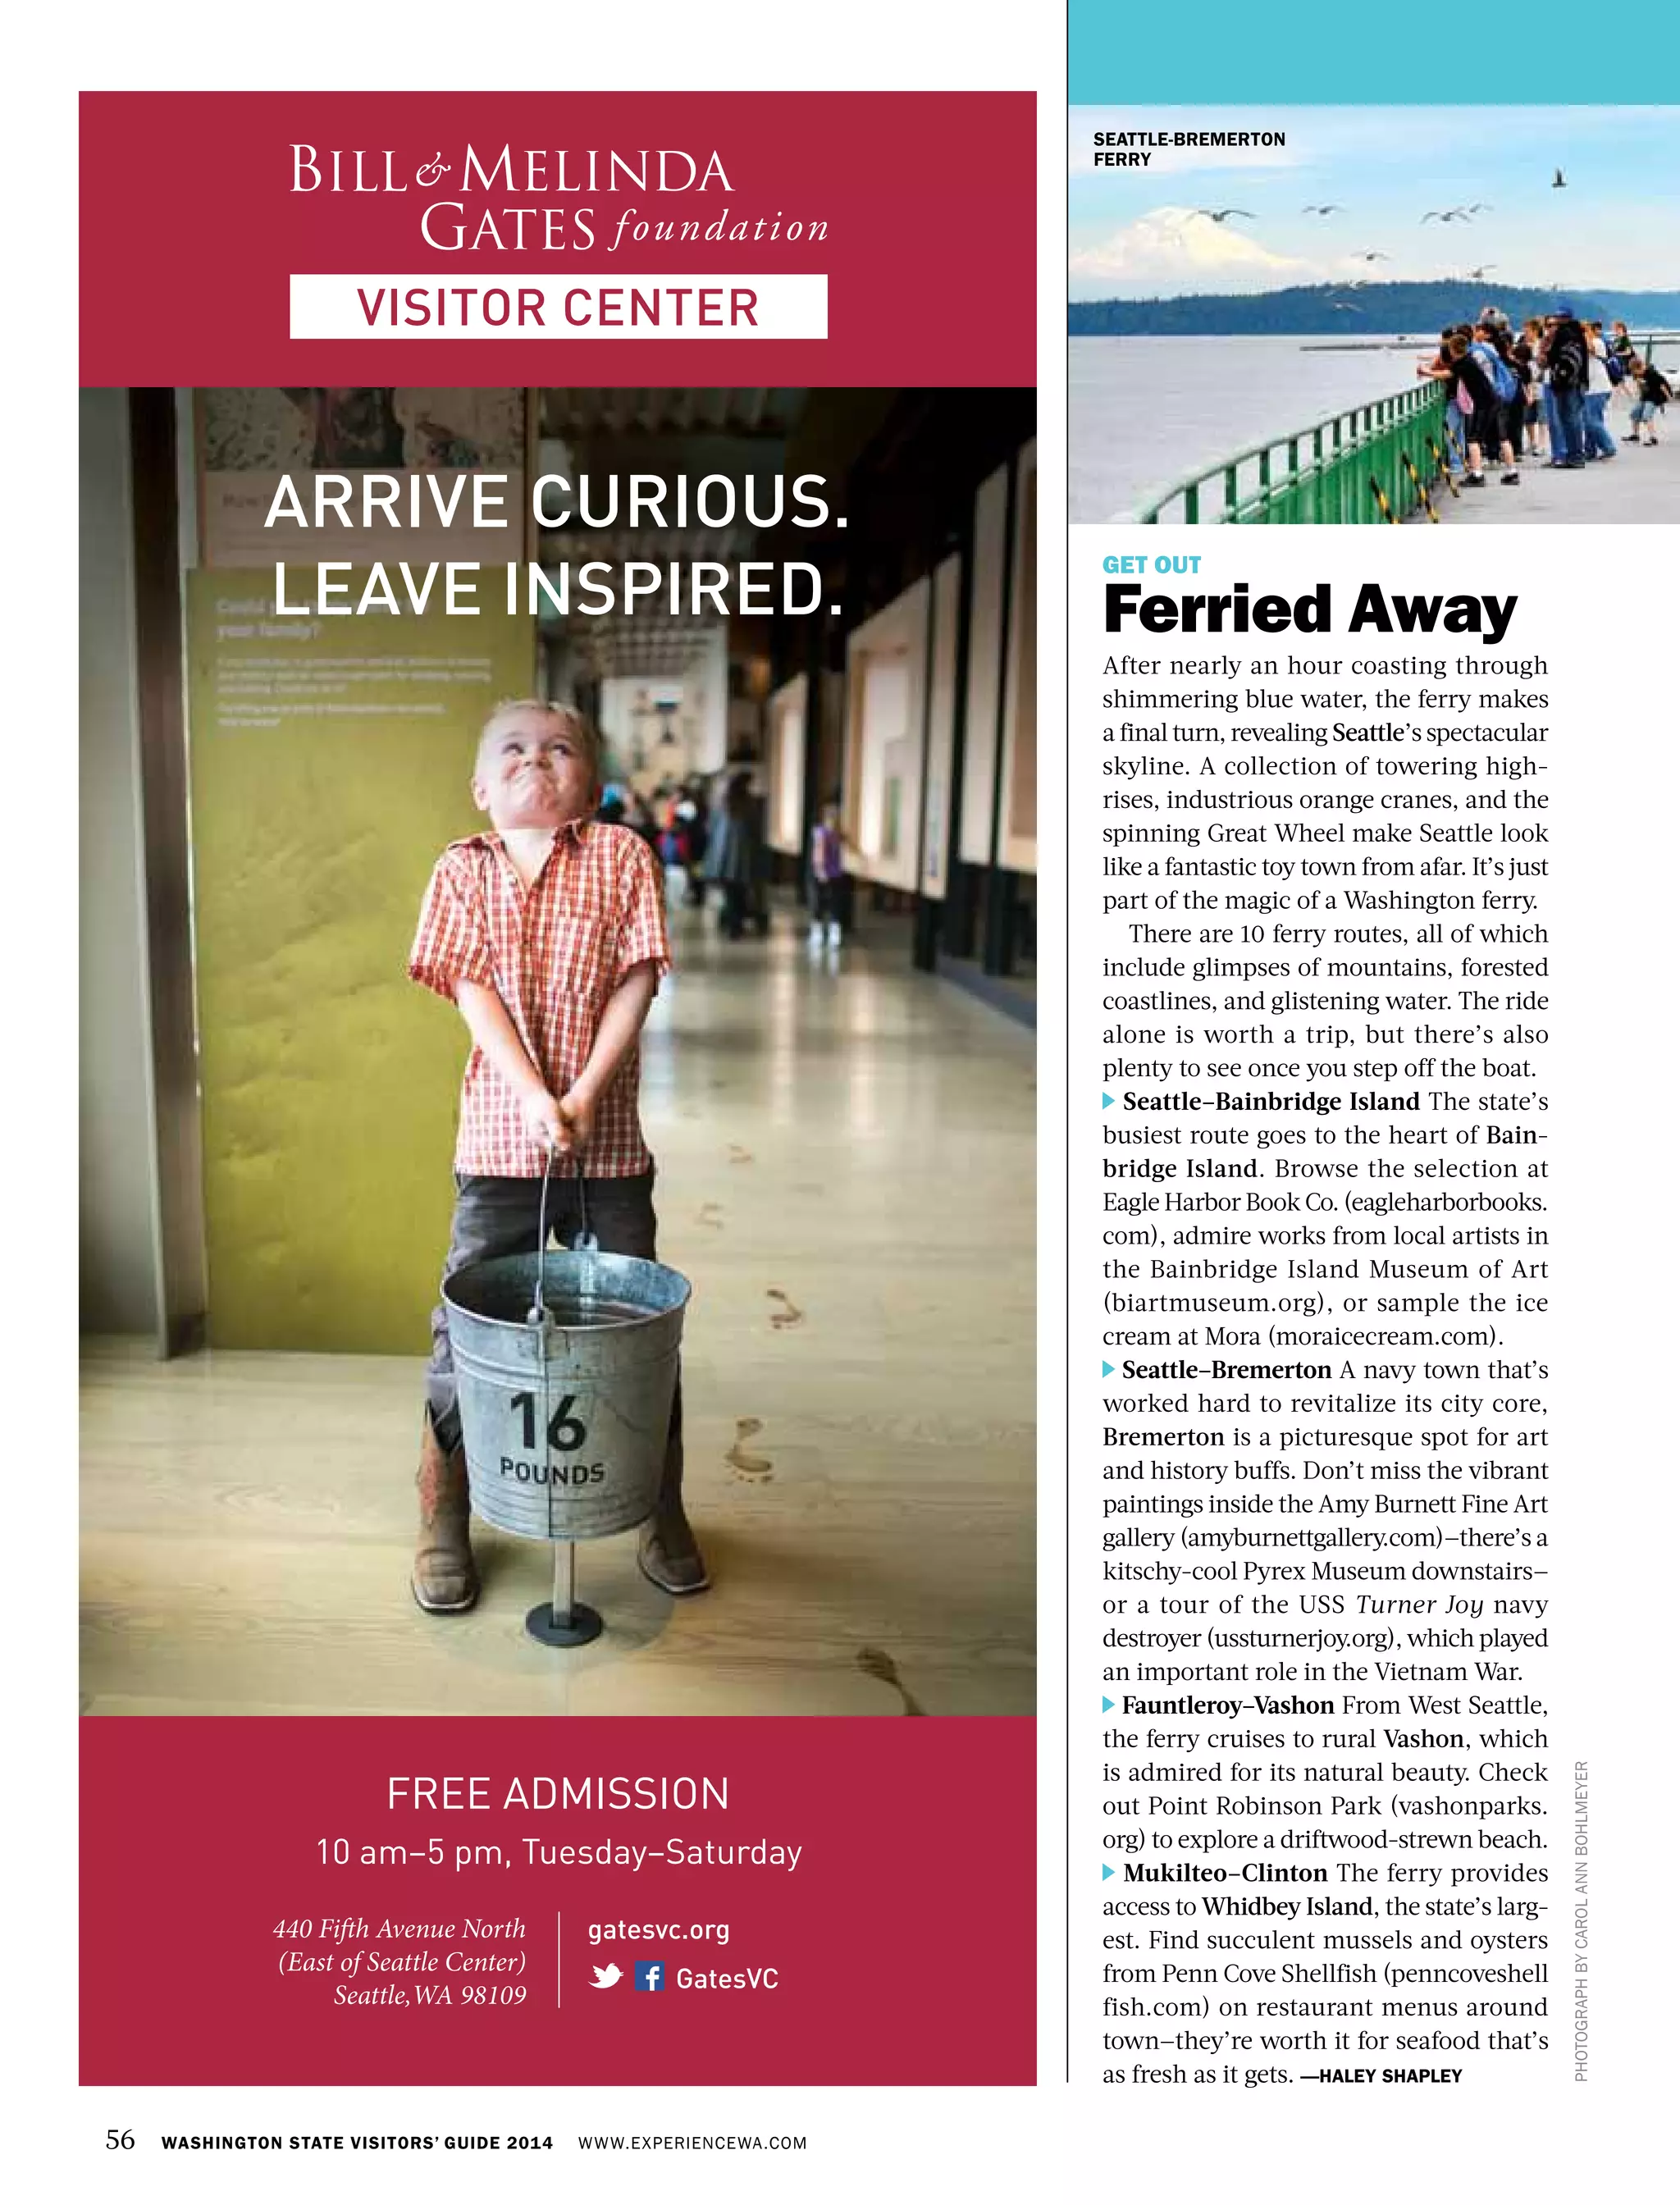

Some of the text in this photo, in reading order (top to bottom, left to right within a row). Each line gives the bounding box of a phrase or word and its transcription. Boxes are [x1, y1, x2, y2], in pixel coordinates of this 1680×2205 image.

[1093, 131, 1285, 147] SEATTLE-BREMERTON
[415, 150, 453, 189] &
[1094, 152, 1152, 167] FERRY
[607, 208, 828, 252] foundation
[357, 288, 758, 326] VISITOR CENTER
[263, 474, 847, 527] ARRIVE CURIOUS.
[1102, 555, 1202, 574] GET OUT
[276, 561, 841, 615] LEAVE INSPIRED.
[1105, 582, 1519, 645] Ferried Away
[1102, 655, 1549, 680] After nearly an hour coasting through
[1102, 722, 1550, 747] a final turn, revealing Seattle’s spectacular
[1102, 823, 1550, 847] spinning Great Wheel make Seattle look
[1102, 990, 1549, 1016] coastlines, and glistening water. The ride
[1102, 1057, 1536, 1082] plenty to see once you step off the boat.
[1102, 1189, 1547, 1217] Eagle Harbor Book Co. (eagleharborbooks.
[1104, 1290, 1548, 1317] (biartmuseum.org), or sample the ice
[1102, 1324, 1504, 1349] cream at Mora (moraicecream.com).
[509, 1391, 588, 1452] 16
[1102, 1427, 1549, 1451] Bremerton is a picturesque spot for art
[500, 1455, 605, 1486] POUNDS
[1102, 1493, 1549, 1518] paintings inside the Amy Burnett Fine Art
[1102, 1594, 1550, 1619] or a tour of the USS Turner Joy navy
[1102, 1661, 1522, 1686] an important role in the Vietnam War.
[1102, 1728, 1549, 1753] the ferry cruises to rural Vashon, which
[389, 1776, 728, 1810] FREE ADMISSION
[317, 1838, 349, 1865] 10
[456, 1846, 511, 1872] pm,
[272, 1917, 526, 1945] 440 Fifth Avenue North
[588, 1920, 729, 1946] gatesvc.org
[1574, 1761, 1588, 2082] PHOTOGRAPH BY CAROL ANN BOHLMEYER
[279, 1950, 526, 1979] (East of Seattle Center)
[1102, 1961, 1549, 1988] from Penn Cove Shellfish (penncoveshell
[677, 1967, 778, 1989] GatesVC
[334, 1984, 527, 2007] Seattle, WA 98109
[1102, 2069, 1125, 2084] as
[1132, 2063, 1188, 2084] fresh
[1194, 2069, 1217, 2084] as
[1222, 2065, 1239, 2084] it
[1244, 2066, 1294, 2089] gets.
[1381, 2068, 1463, 2084] SHAPLEY
[106, 2129, 135, 2150] 56
[161, 2136, 554, 2150] WASHINGTON STATE VISITORS’ GUIDE 2014
[578, 2136, 806, 2150] WWW.EXPERIENCEWA.COM
